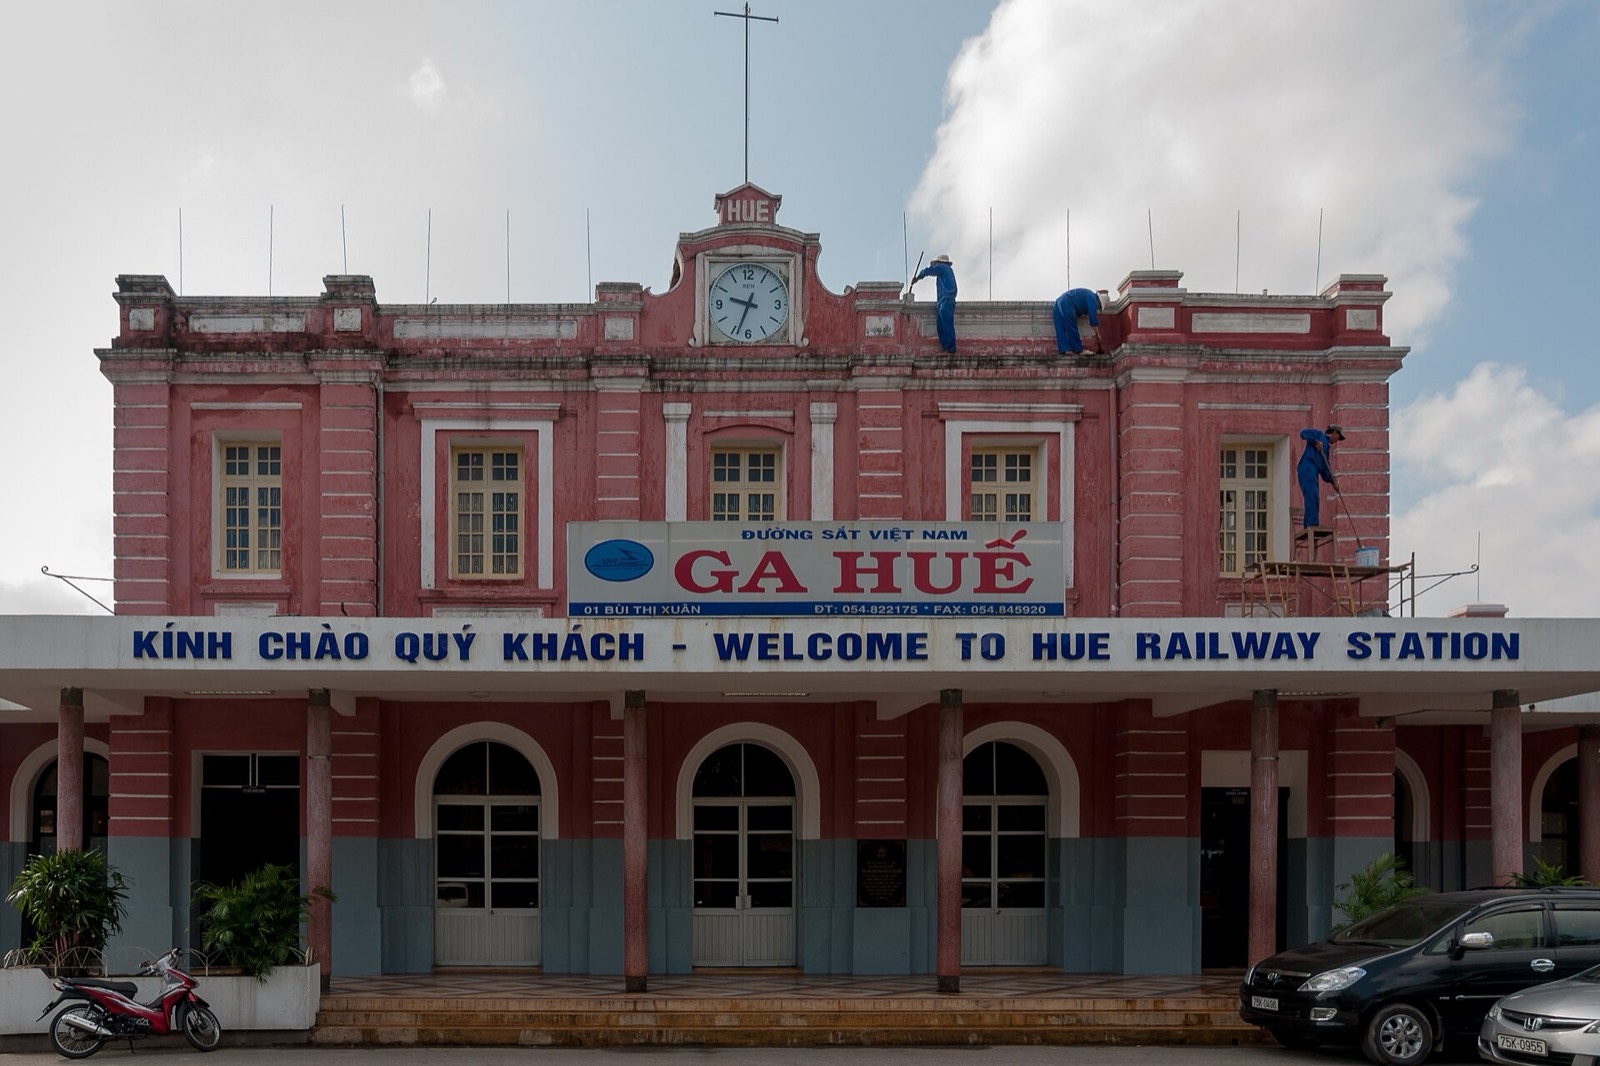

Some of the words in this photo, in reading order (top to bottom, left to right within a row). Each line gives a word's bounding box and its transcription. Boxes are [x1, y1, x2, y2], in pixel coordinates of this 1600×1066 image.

[727, 199, 769, 222] HUE
[742, 269, 755, 280] 12
[715, 300, 723, 310] 9
[774, 300, 782, 310] 3
[744, 329, 753, 339] 6
[741, 527, 813, 540] ĐƯỜNG
[822, 526, 861, 540] SẮT
[869, 527, 914, 542] VIỆT
[922, 530, 968, 540] NAM
[674, 550, 808, 593] GA
[832, 529, 1034, 594] HUẾ
[584, 606, 598, 615] 01
[604, 603, 629, 615] BÙI
[633, 605, 656, 616] THỊ
[661, 603, 701, 615] XUÂN
[814, 604, 838, 614] ĐT:
[842, 604, 918, 615] 054.822175
[934, 604, 967, 615] FAX:
[971, 604, 1046, 615] 054.845920
[133, 622, 232, 659] KÍNH
[258, 623, 370, 660] CHÀO
[394, 624, 477, 663] QUÝ
[503, 624, 645, 661] KHÁCH
[713, 632, 929, 662] WELCOME
[956, 632, 1006, 661] TO
[1032, 632, 1111, 661] HUE
[1136, 632, 1321, 660] RAILWAY
[1346, 632, 1520, 660] STATION
[1500, 1036, 1543, 1053] 75K-0955
